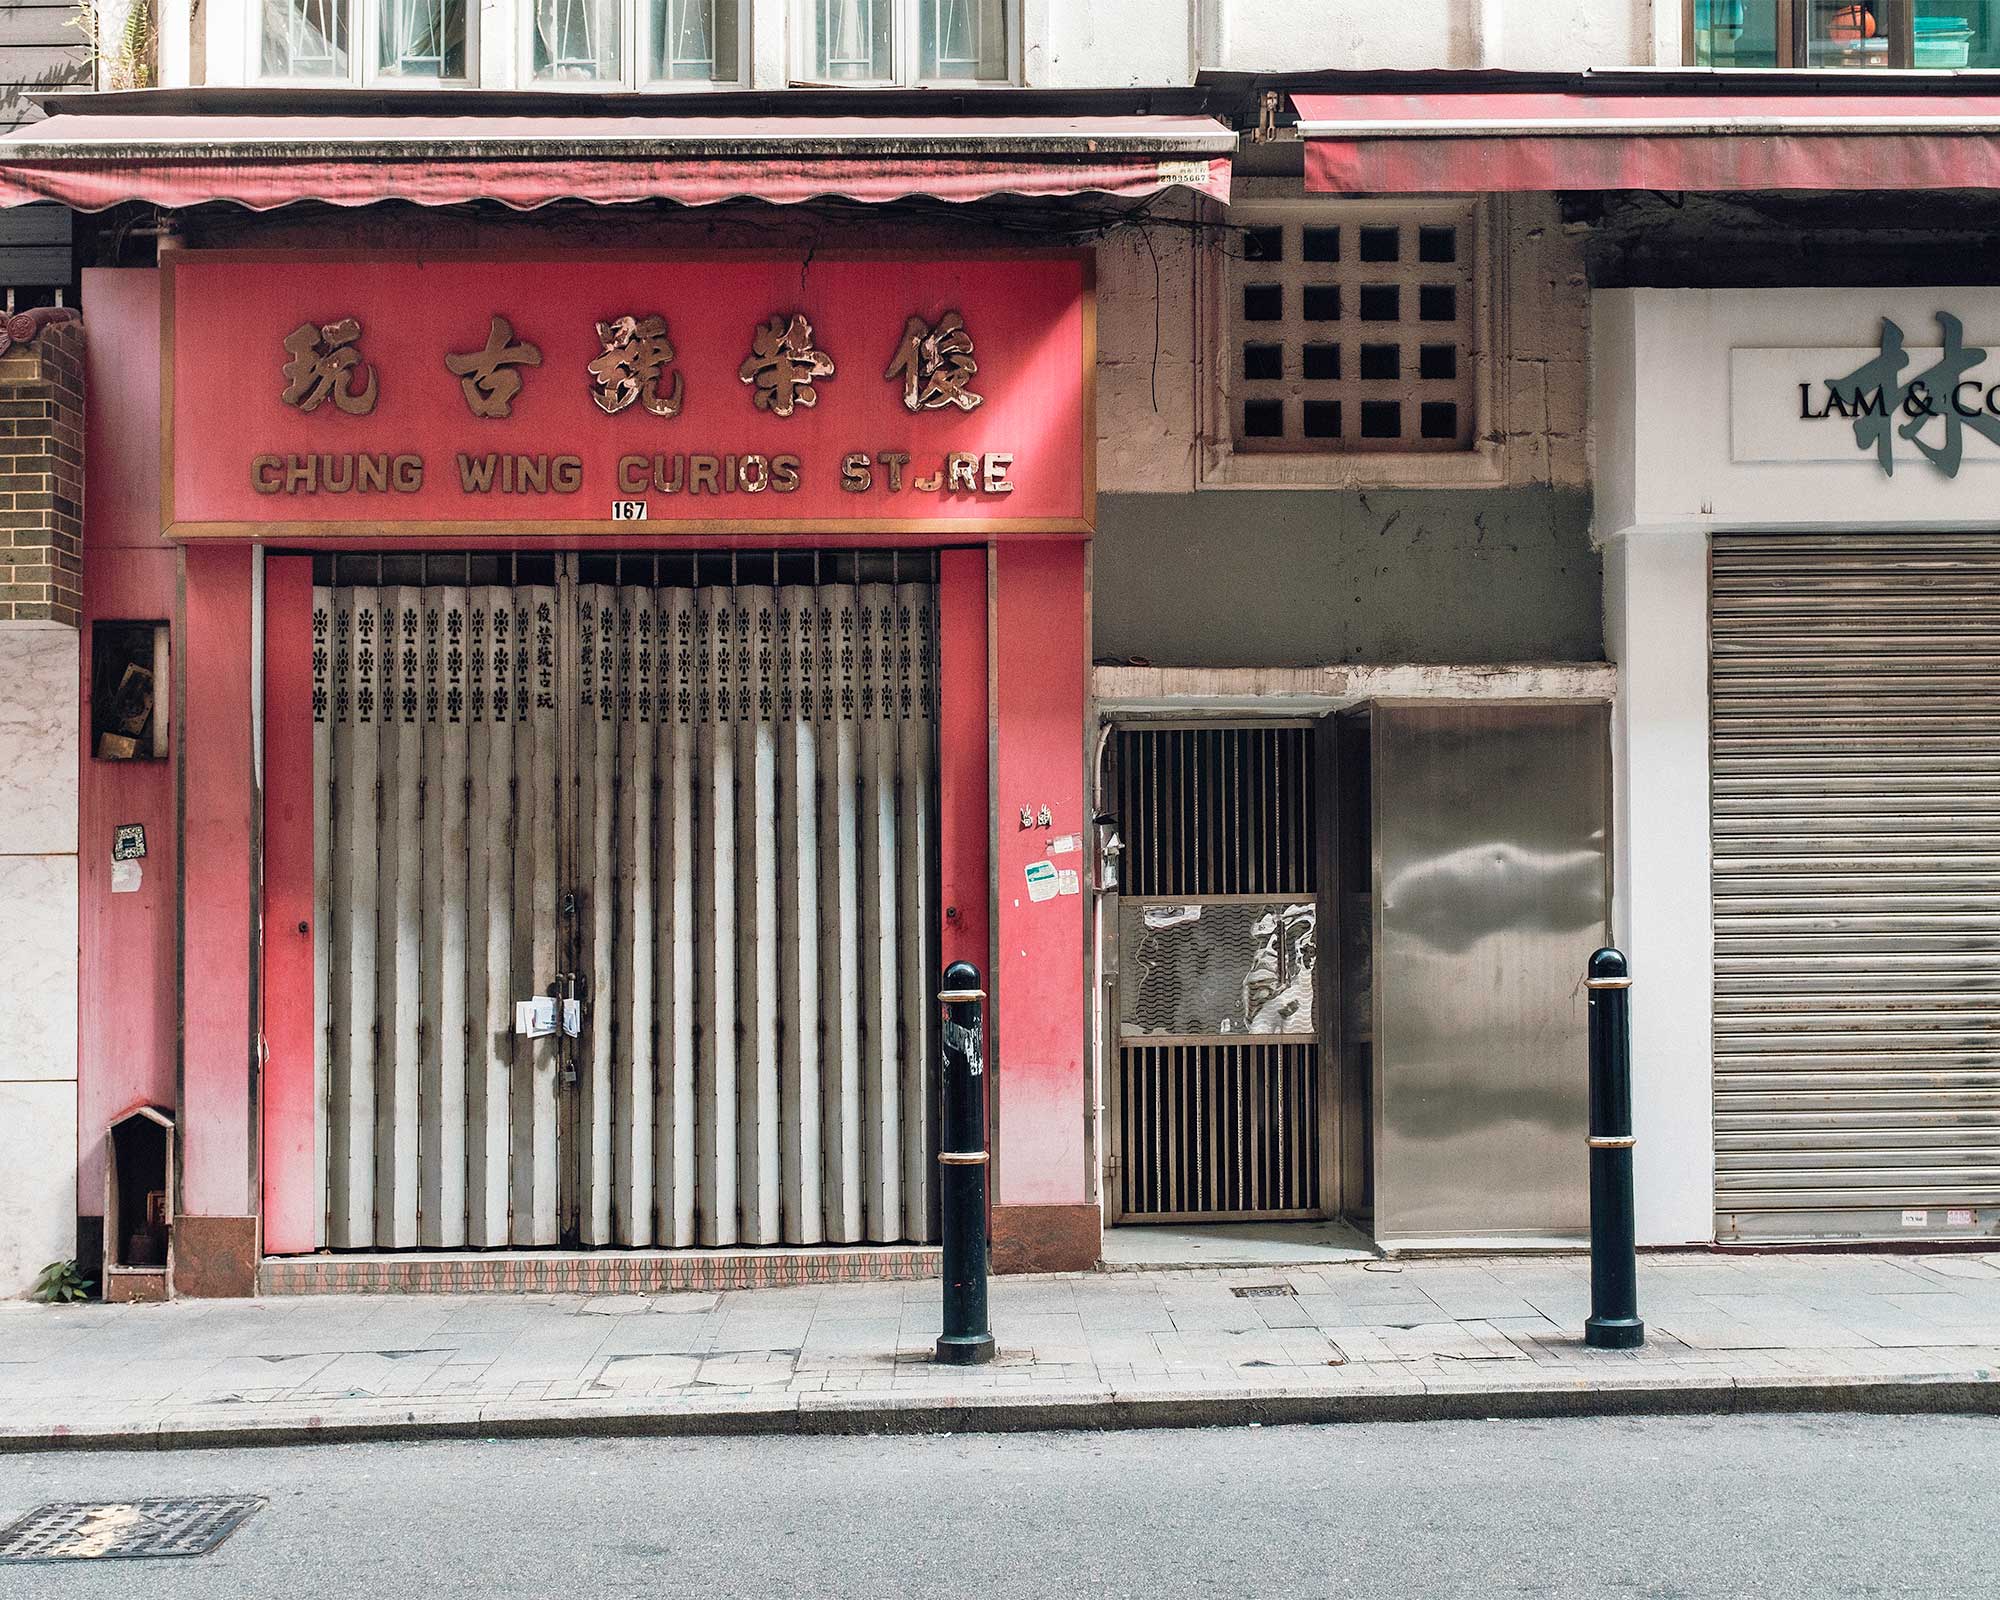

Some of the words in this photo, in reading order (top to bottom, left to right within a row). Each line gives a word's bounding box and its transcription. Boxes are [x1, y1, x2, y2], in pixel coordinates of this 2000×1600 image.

[1799, 383, 1889, 418] LAM
[1903, 380, 1938, 417] &
[1824, 310, 2000, 479] 林
[251, 453, 424, 494] CHUNG
[456, 453, 583, 494] WING
[618, 454, 801, 494] CURIOS
[614, 502, 645, 519] 167
